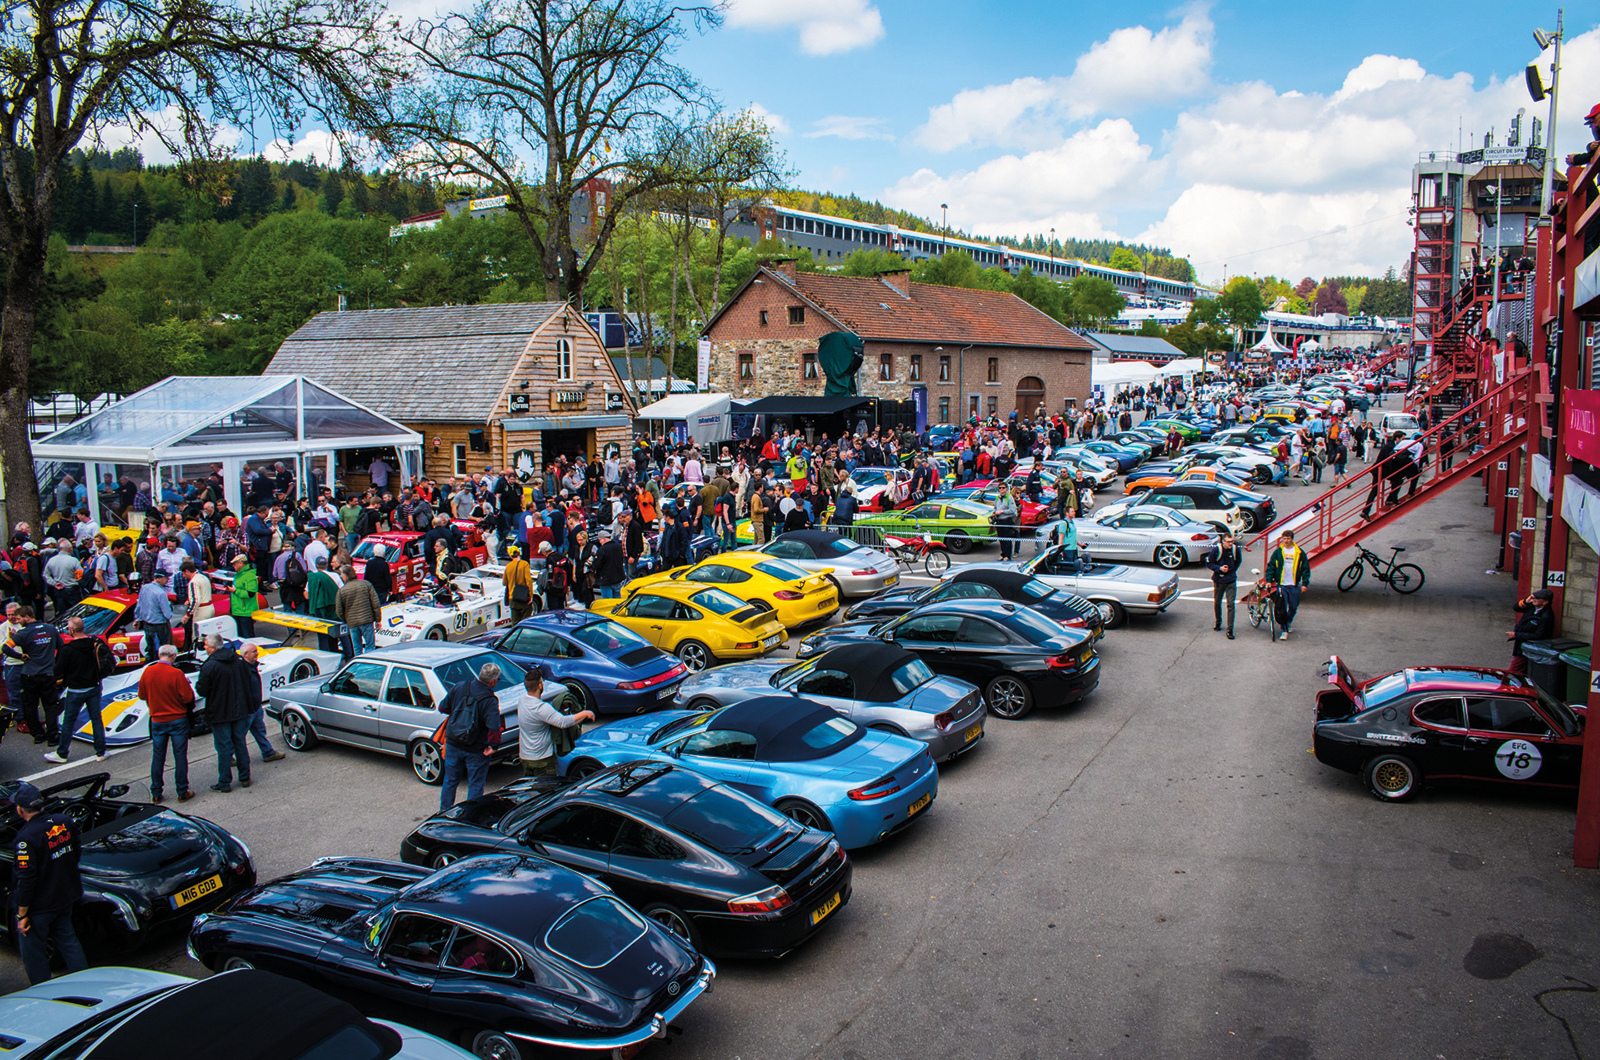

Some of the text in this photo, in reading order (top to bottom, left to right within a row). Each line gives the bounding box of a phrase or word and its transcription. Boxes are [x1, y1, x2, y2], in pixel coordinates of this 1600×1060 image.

[511, 401, 529, 411] Corona
[608, 400, 622, 409] Corona
[1523, 519, 1535, 528] 43
[413, 563, 424, 581] 5
[1548, 573, 1564, 583] 44
[456, 612, 468, 629] 26
[270, 676, 286, 691] 88
[1592, 675, 1600, 689] 4
[1366, 732, 1427, 745] SWITZERLAND
[1511, 742, 1528, 751] EFG
[1505, 751, 1532, 769] 18
[48, 832, 71, 850] Red Bull
[181, 878, 217, 903] M16 GDB
[670, 983, 678, 993] GB
